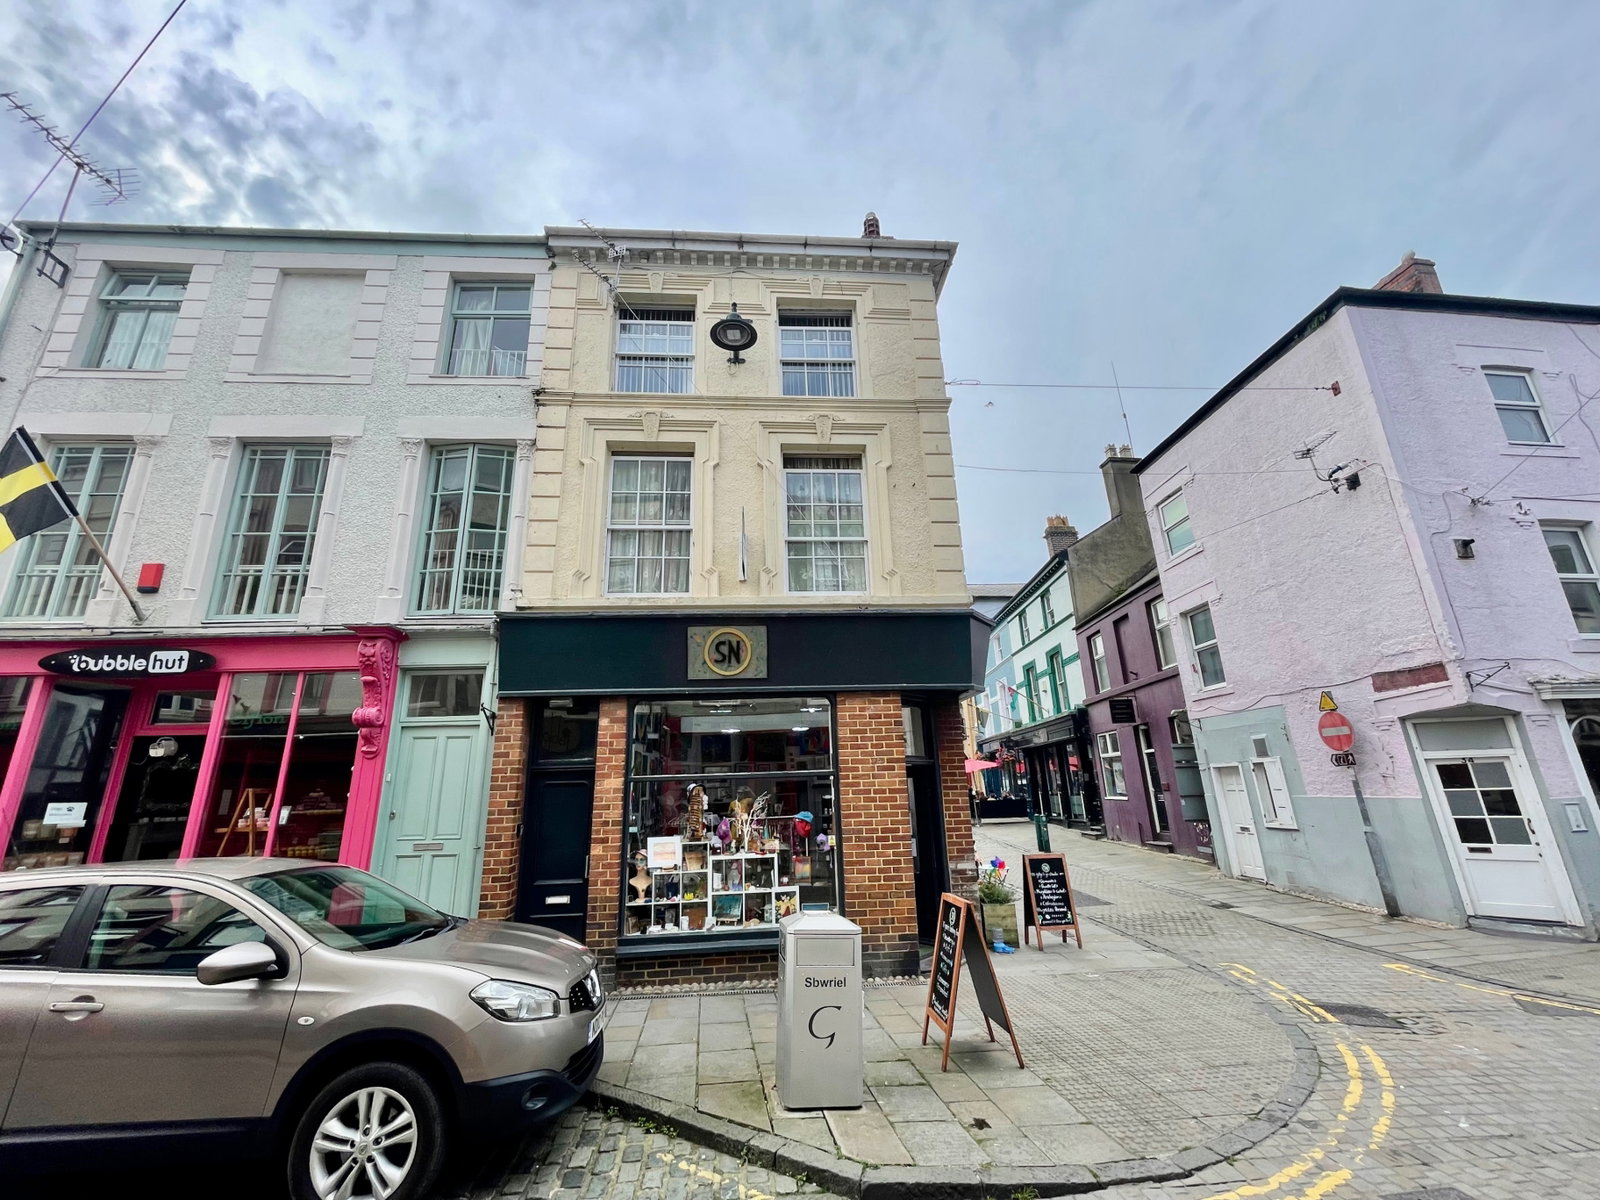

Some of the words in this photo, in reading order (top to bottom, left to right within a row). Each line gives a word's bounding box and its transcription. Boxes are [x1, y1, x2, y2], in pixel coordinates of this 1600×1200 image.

[714, 640, 741, 665] SN
[71, 654, 147, 672] bubble
[151, 654, 186, 671] hut
[804, 976, 847, 988] Sbwriel
